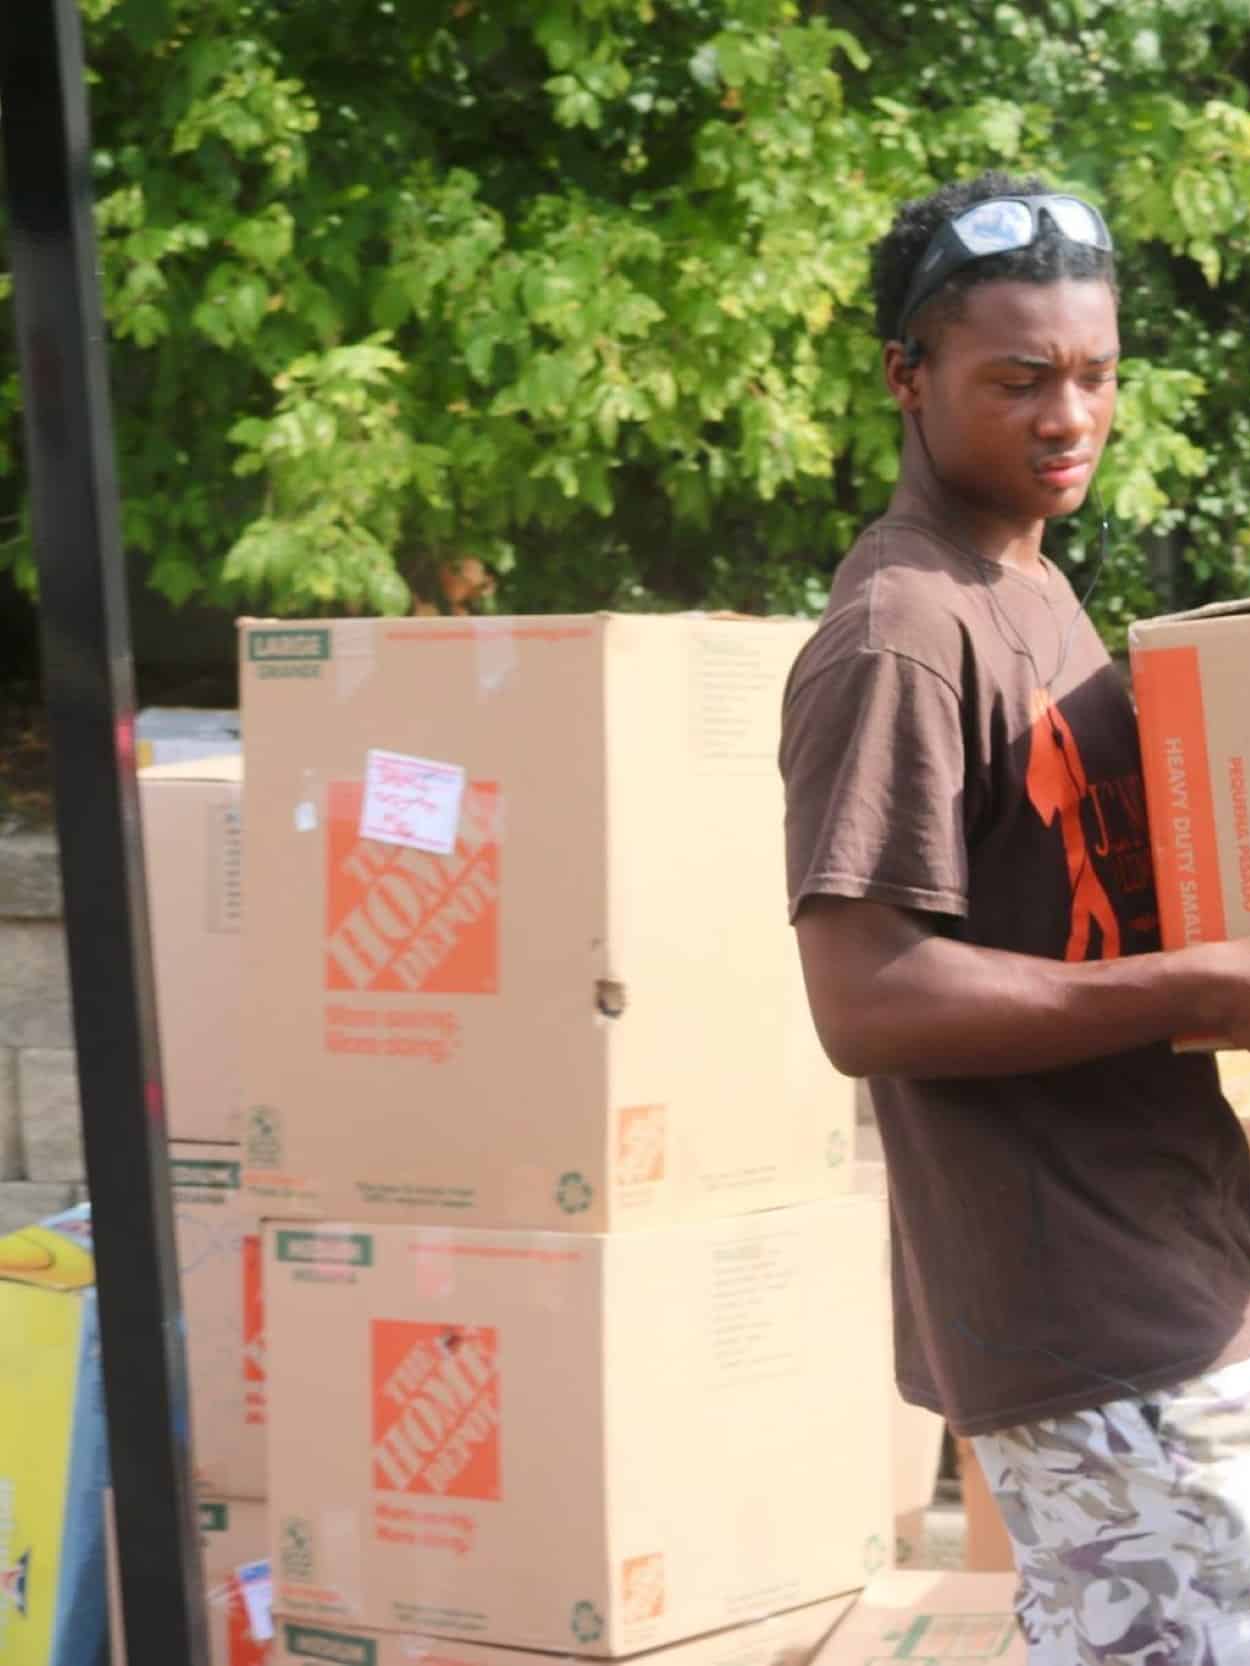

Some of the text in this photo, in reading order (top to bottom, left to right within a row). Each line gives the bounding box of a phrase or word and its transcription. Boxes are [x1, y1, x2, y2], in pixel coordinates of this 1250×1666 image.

[1164, 736, 1204, 945] HEAVY DUTY SMALL
[374, 1328, 502, 1491] HOME
